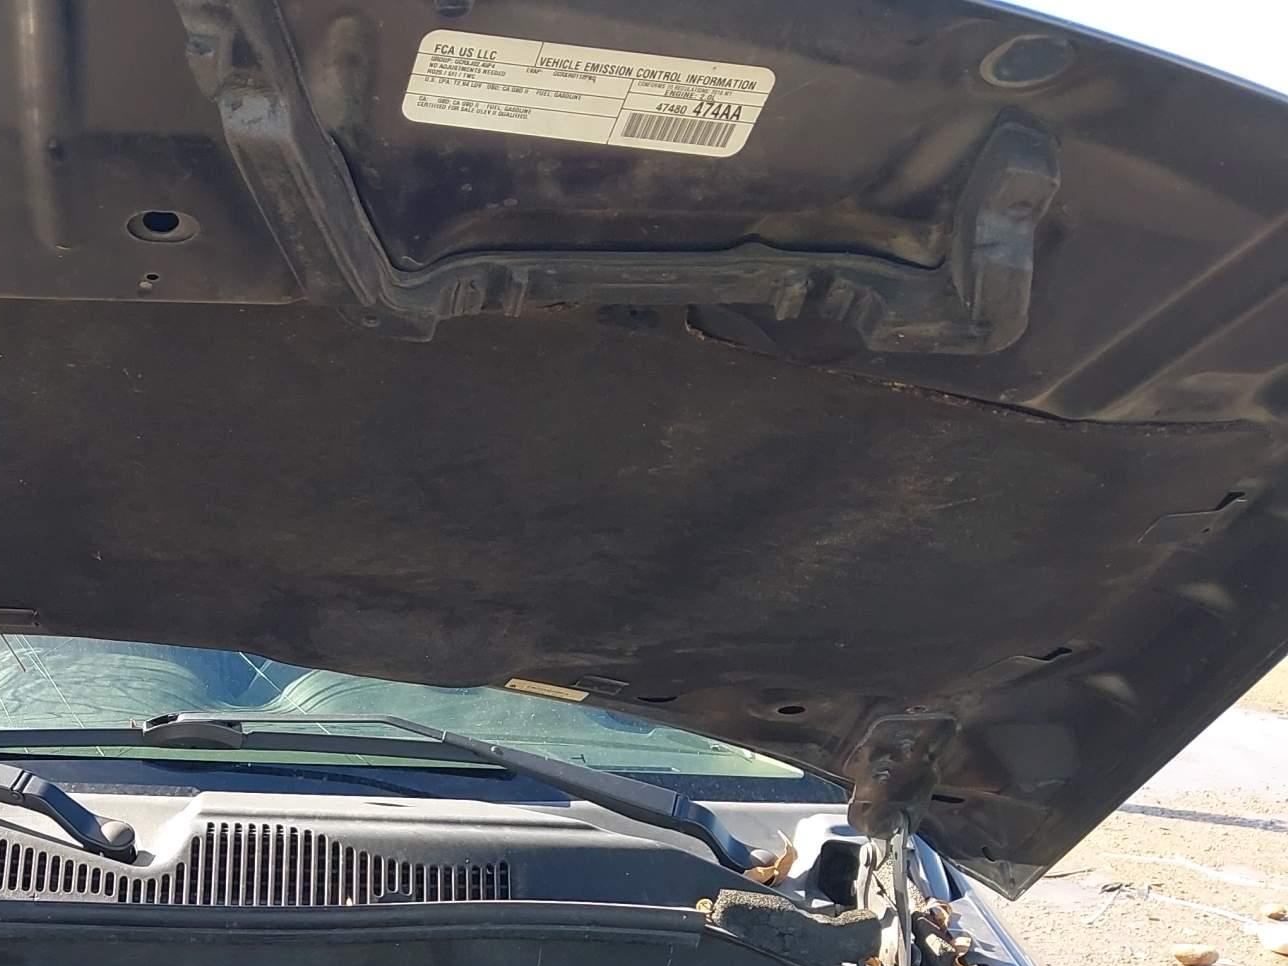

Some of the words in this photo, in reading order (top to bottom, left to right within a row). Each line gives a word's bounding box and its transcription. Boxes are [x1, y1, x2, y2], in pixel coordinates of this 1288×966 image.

[434, 44, 455, 55] FCA
[458, 47, 475, 57] US
[477, 49, 498, 60] LLC
[539, 57, 582, 71] VEHICLE
[584, 62, 634, 77] EMISSION
[636, 68, 682, 82] CONTROL
[686, 74, 758, 90] INFORMATION
[655, 102, 689, 115] 47480
[692, 102, 744, 121] 474AA
